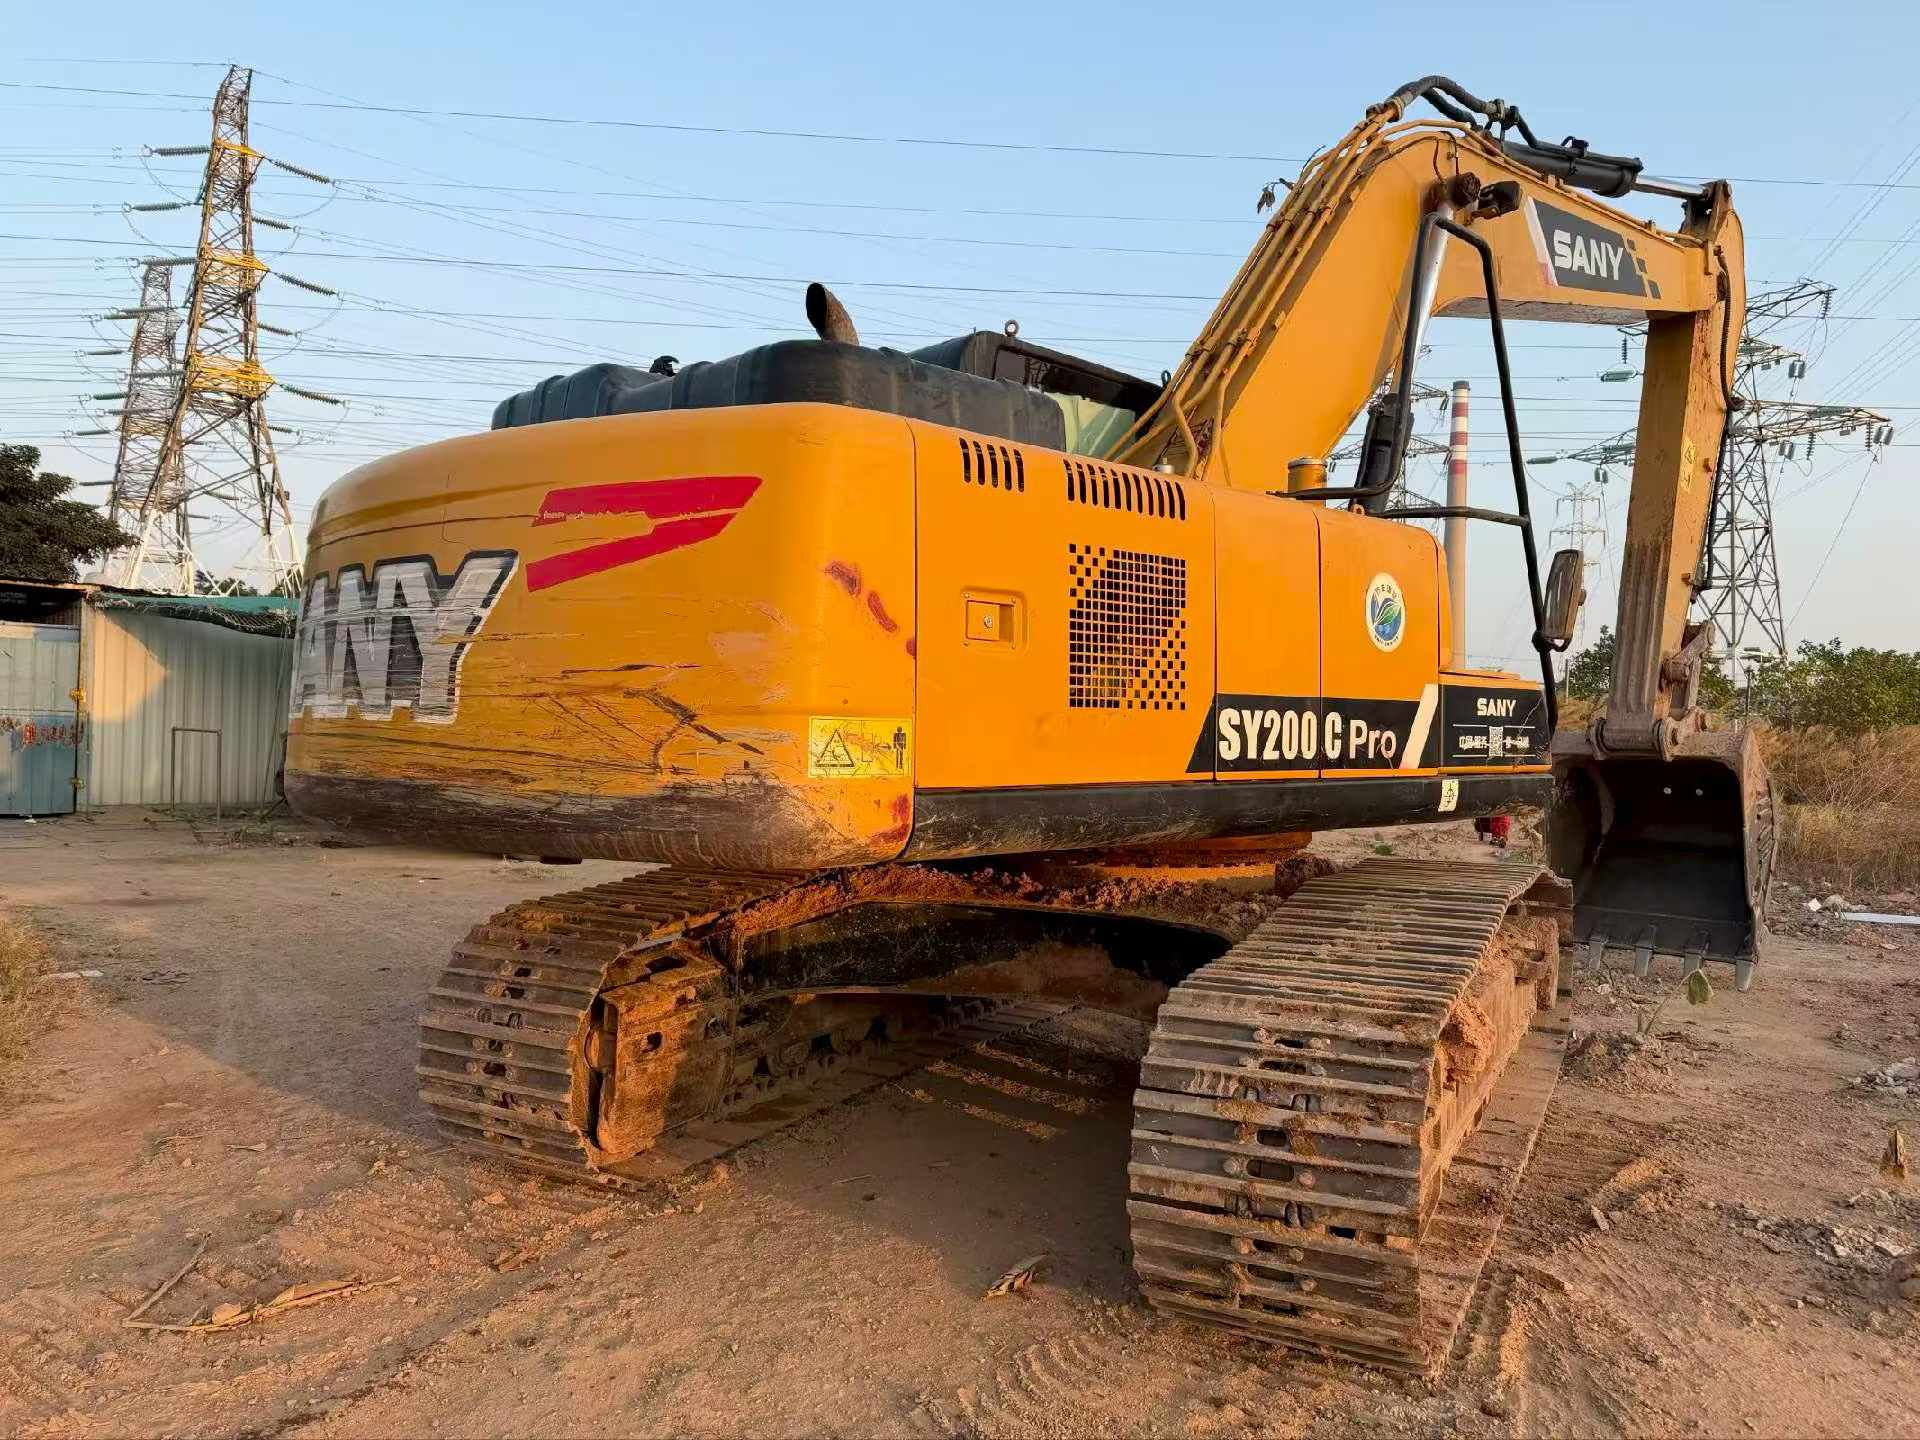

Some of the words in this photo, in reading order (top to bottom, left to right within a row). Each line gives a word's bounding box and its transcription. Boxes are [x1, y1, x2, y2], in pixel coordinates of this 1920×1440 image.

[1553, 229, 1624, 281] SANY
[287, 549, 518, 724] ANY
[1476, 697, 1516, 717] SANY
[1349, 719, 1397, 759] Pro
